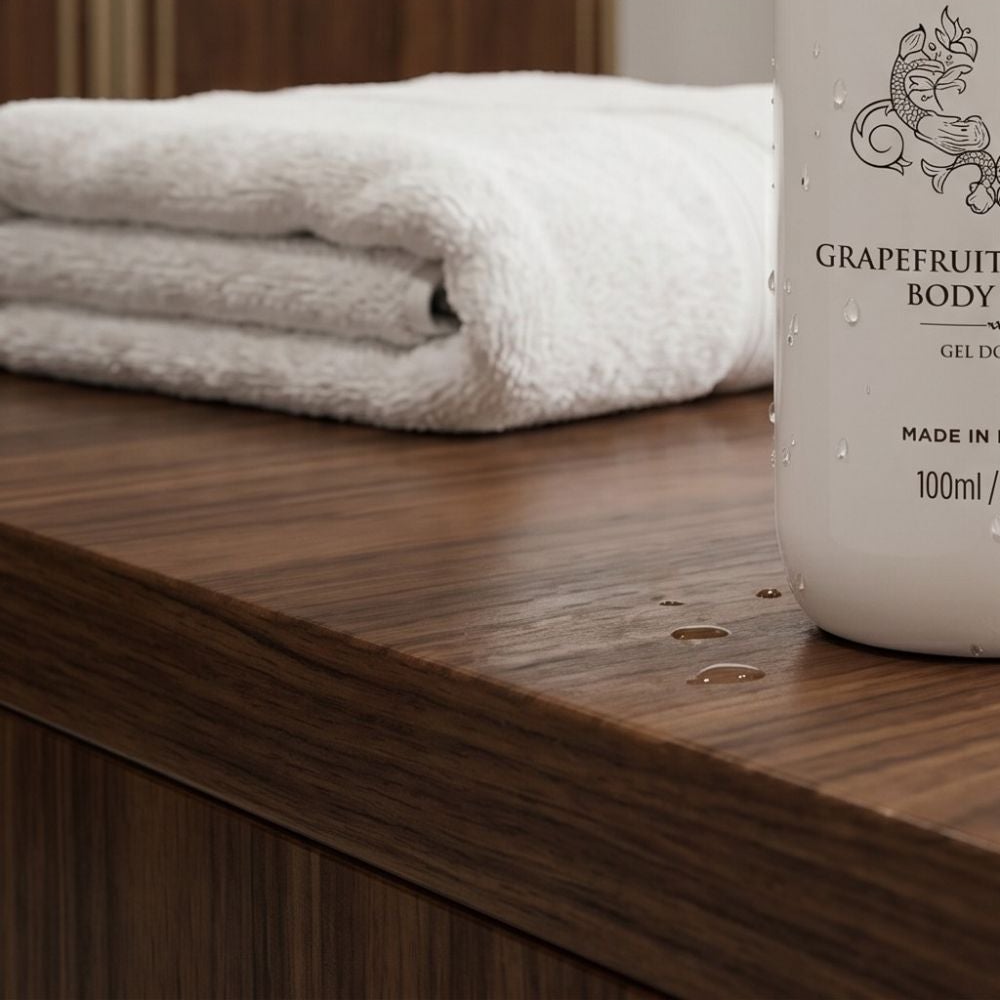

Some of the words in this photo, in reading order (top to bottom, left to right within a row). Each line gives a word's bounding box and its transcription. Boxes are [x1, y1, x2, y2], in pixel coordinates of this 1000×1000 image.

[907, 282, 996, 308] BODY
[940, 344, 975, 360] GEL
[902, 426, 960, 443] MADE
[969, 429, 989, 444] IN
[917, 470, 981, 500] 100ml
